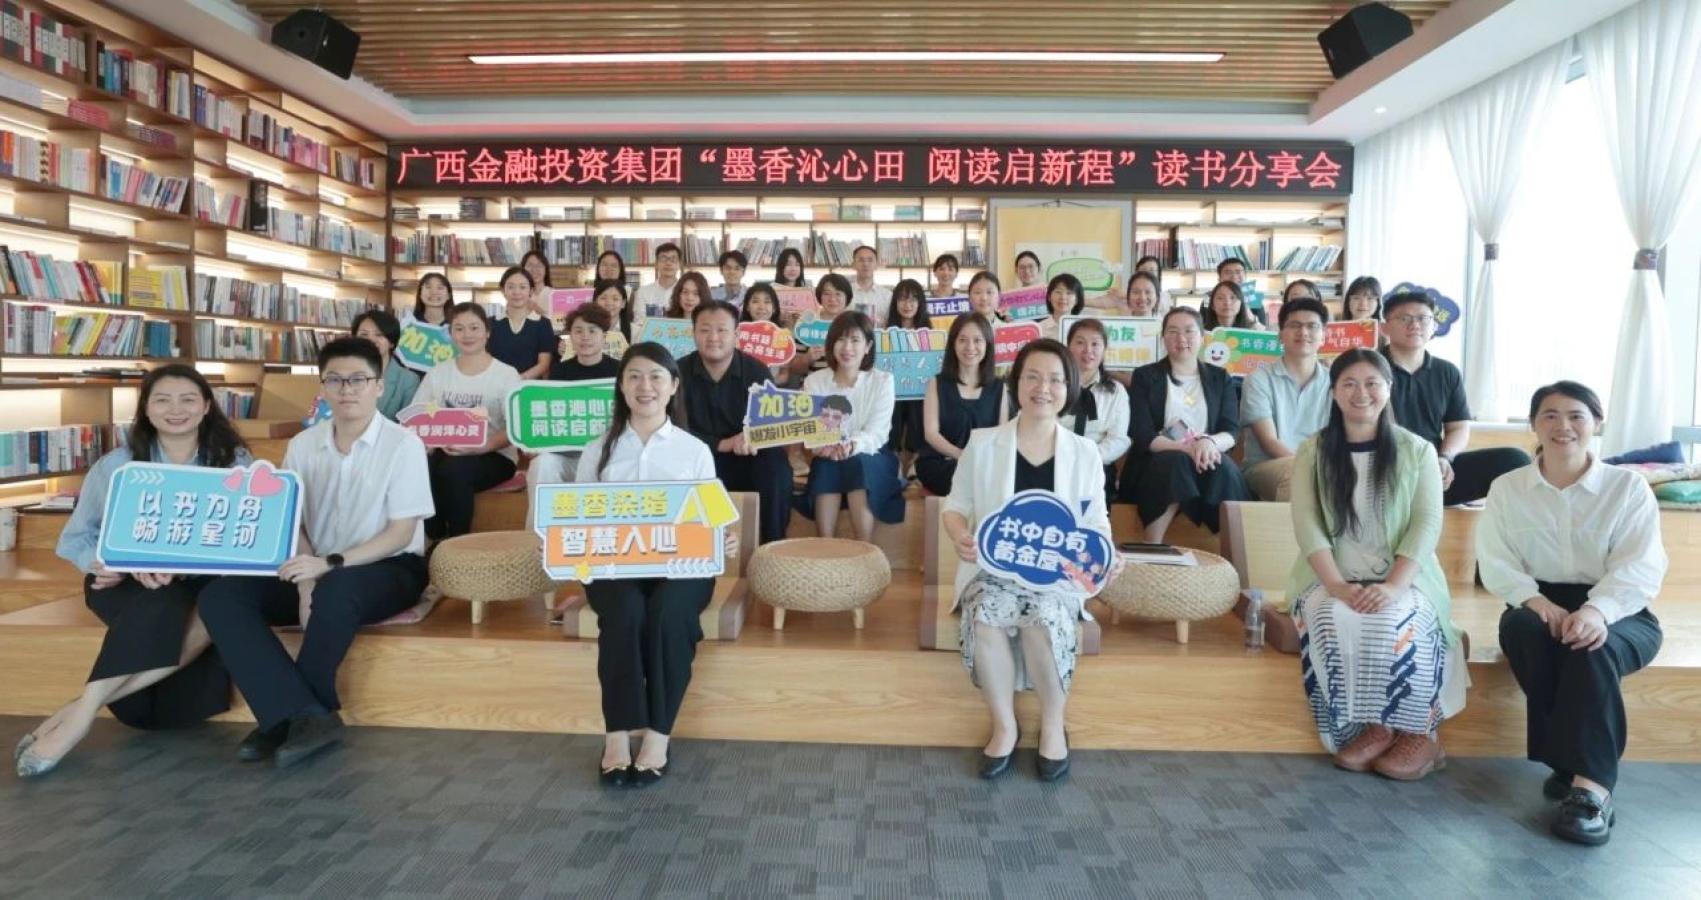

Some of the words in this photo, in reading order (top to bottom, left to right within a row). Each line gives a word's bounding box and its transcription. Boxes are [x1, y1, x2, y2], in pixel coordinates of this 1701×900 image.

[758, 393, 813, 417] 加油
[415, 424, 480, 437] 香润泽心灵
[532, 419, 612, 436] 阅读启新
[552, 489, 668, 519] 墨香染指
[132, 517, 259, 549] 畅游星河
[998, 516, 1089, 553] 书中自有
[993, 540, 1061, 572] 黄金屋
